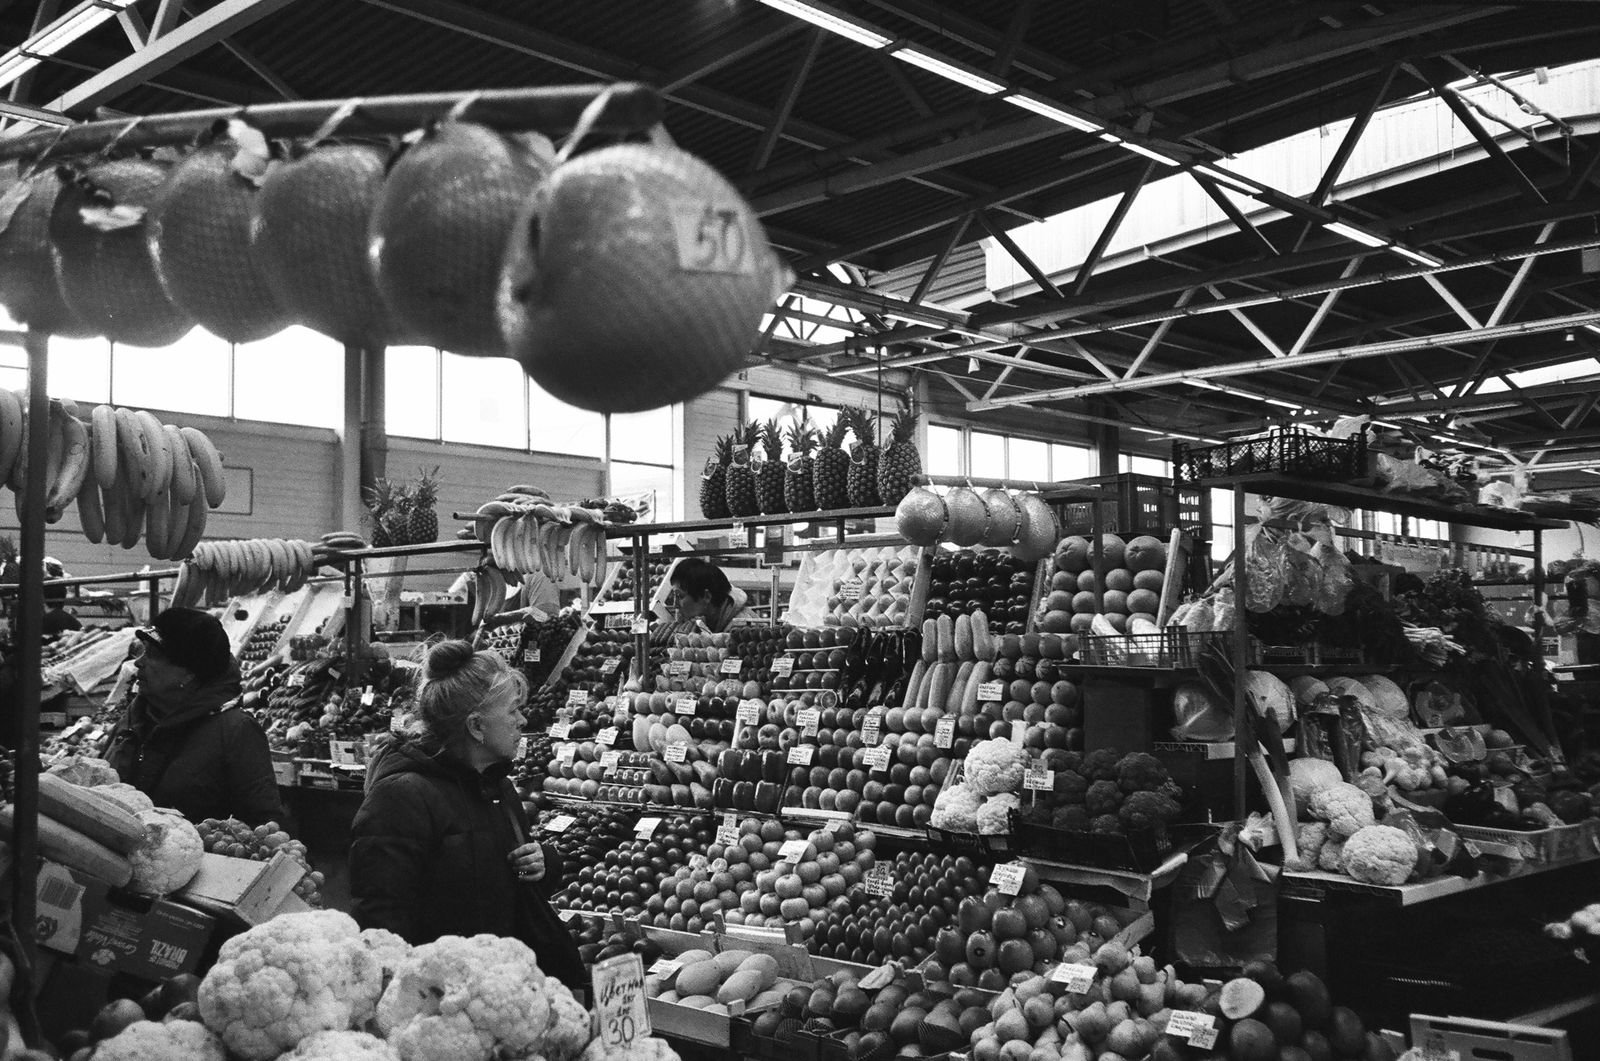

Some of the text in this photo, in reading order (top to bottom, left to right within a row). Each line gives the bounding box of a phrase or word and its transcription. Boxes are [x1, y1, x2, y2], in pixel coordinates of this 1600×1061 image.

[696, 206, 745, 268] 50
[149, 939, 188, 964] BRAZIL
[608, 1015, 635, 1045] 30
